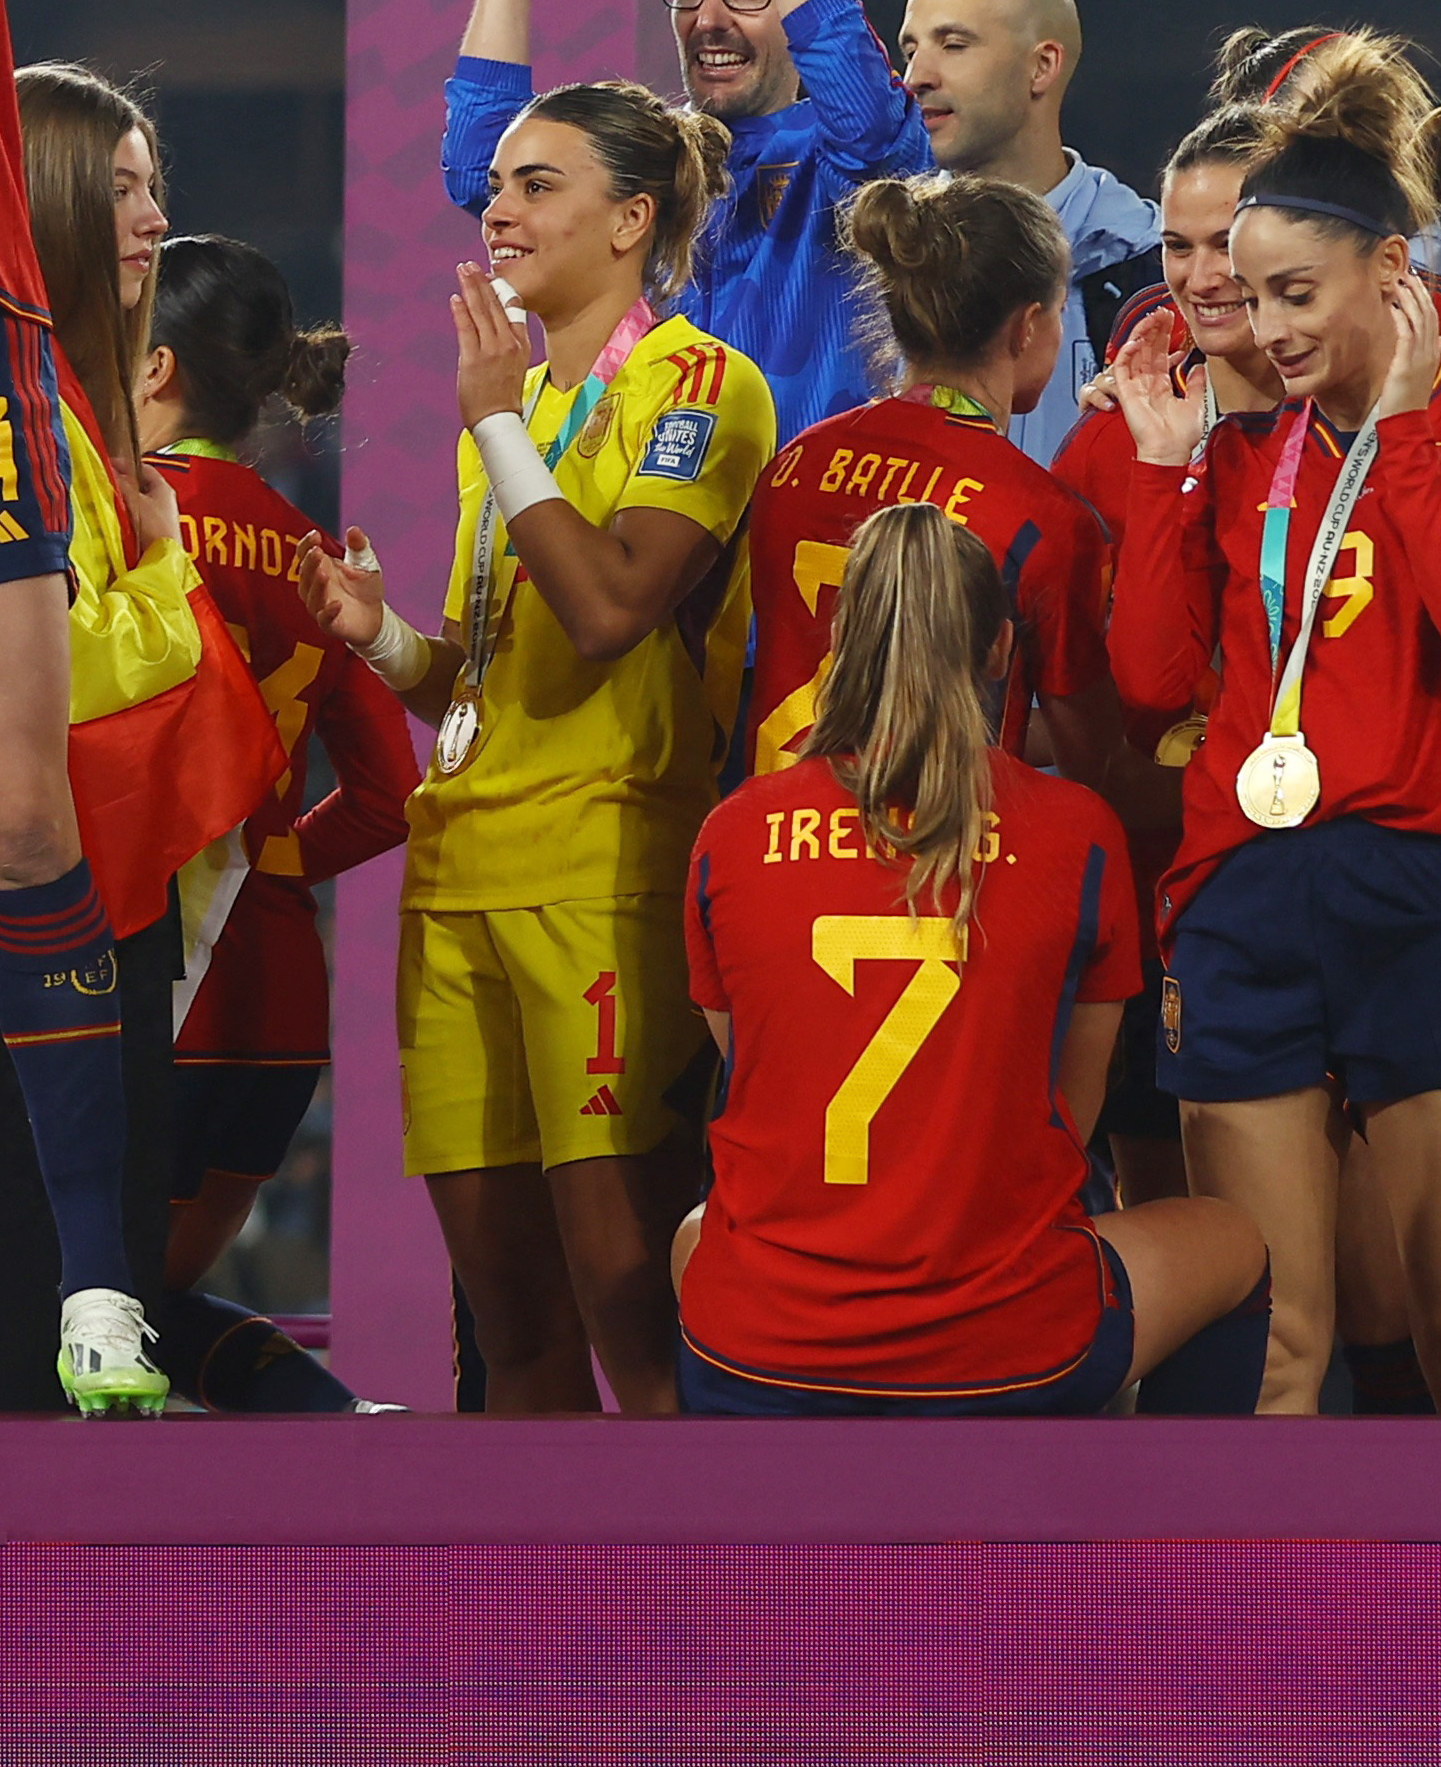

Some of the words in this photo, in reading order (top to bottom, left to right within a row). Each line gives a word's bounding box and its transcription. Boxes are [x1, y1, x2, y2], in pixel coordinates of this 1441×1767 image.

[660, 456, 677, 465] FIFA
[1339, 457, 1365, 502] WORLD
[819, 447, 986, 525] BATLLE
[476, 496, 495, 549] WORLD
[1331, 503, 1346, 531] CUP
[476, 548, 488, 574] CUP
[44, 971, 67, 989] 19
[581, 970, 626, 1075] 1
[812, 916, 969, 1185] 7
